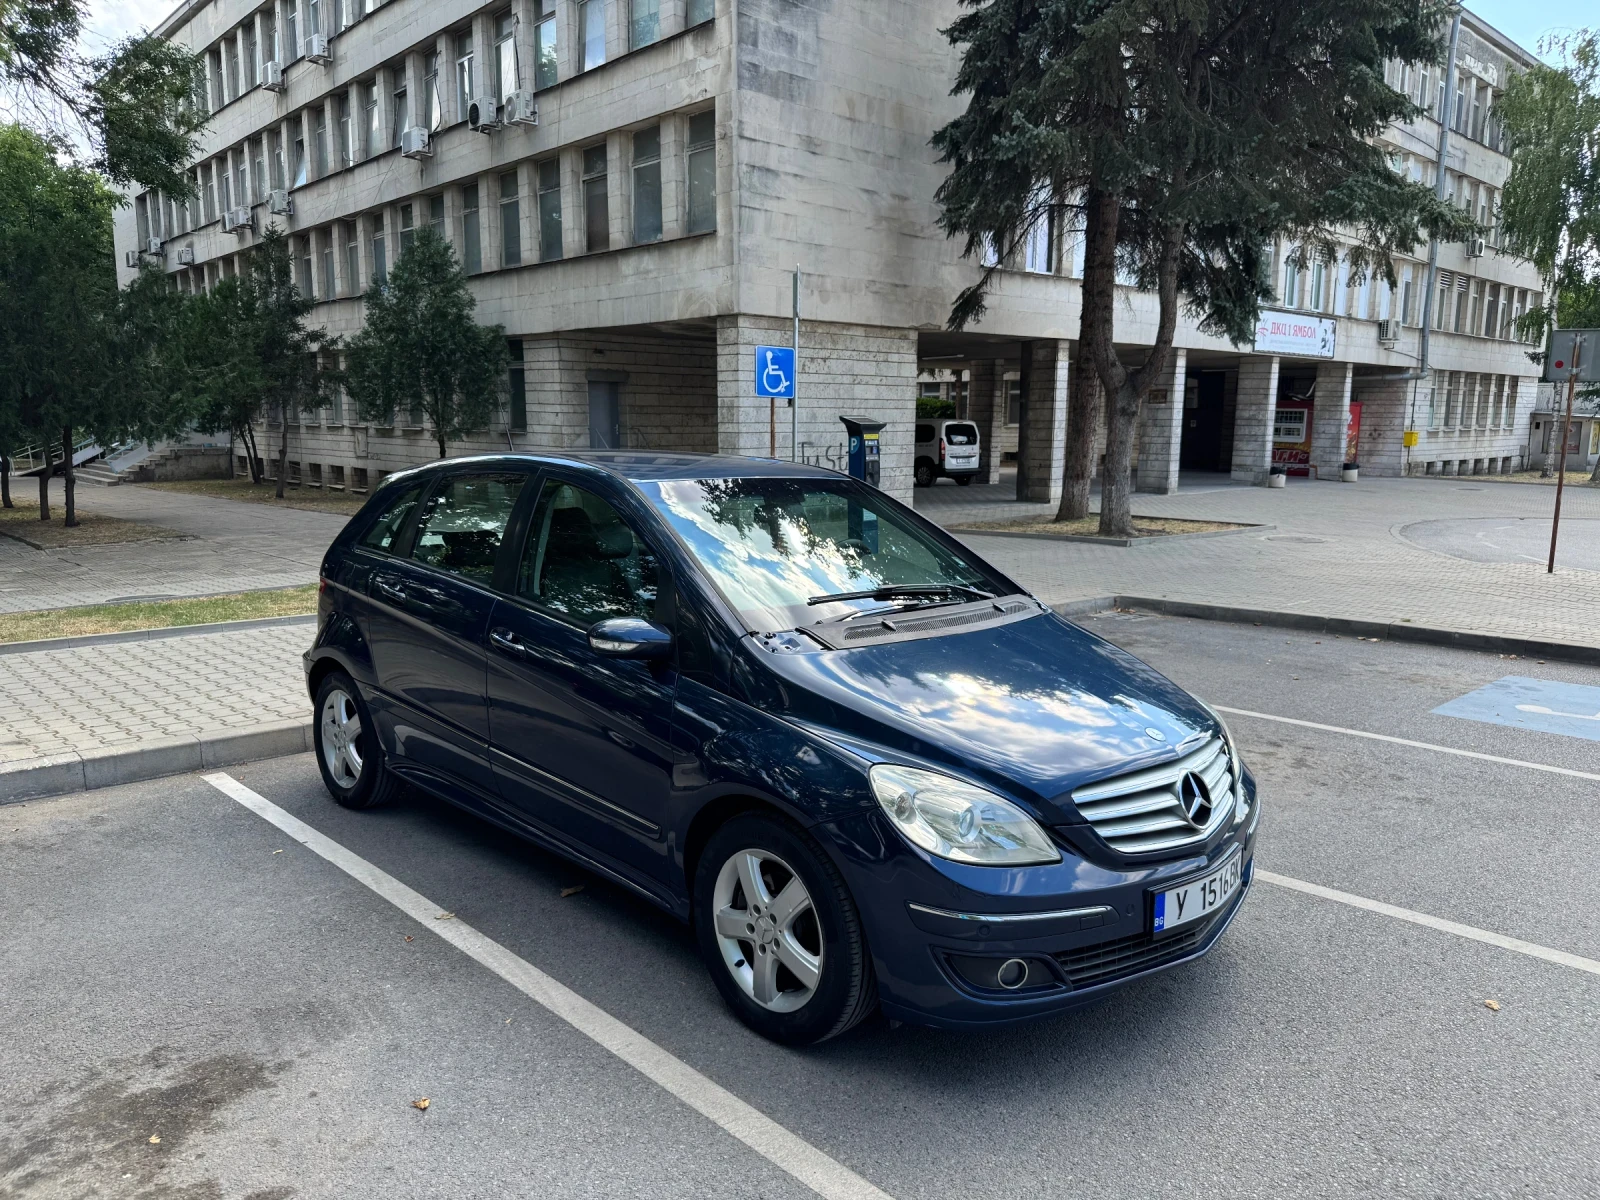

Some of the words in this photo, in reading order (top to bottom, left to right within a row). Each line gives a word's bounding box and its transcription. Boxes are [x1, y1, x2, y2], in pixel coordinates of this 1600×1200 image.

[1270, 322, 1287, 336] ДКЦ
[1293, 325, 1316, 338] ЯМБОЛ
[850, 437, 857, 451] P
[1200, 867, 1229, 910] 1516
[1154, 916, 1164, 926] BG
